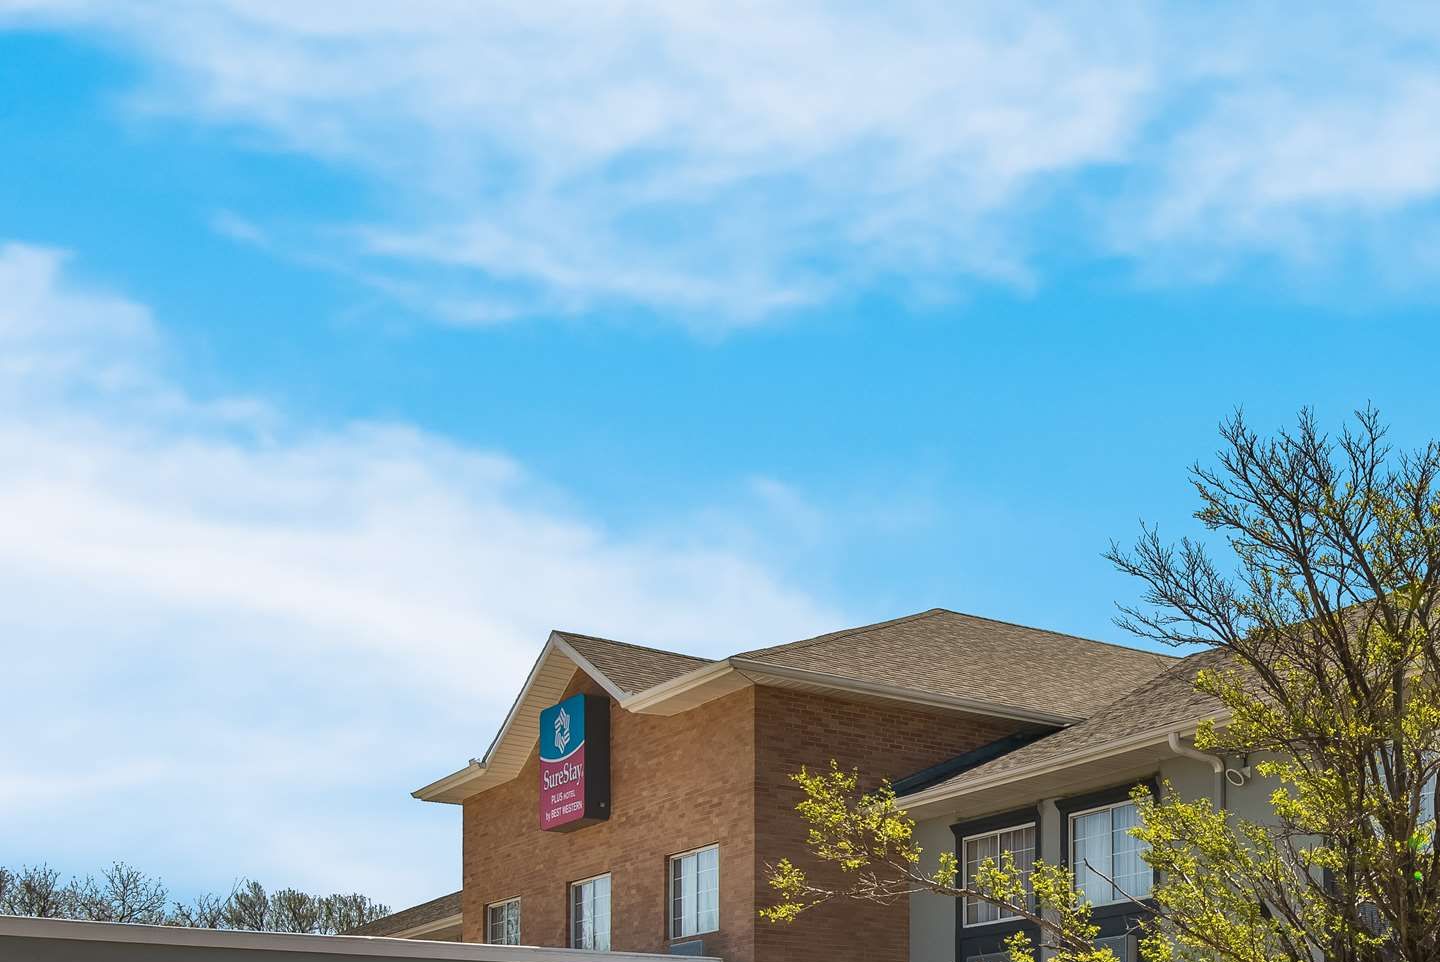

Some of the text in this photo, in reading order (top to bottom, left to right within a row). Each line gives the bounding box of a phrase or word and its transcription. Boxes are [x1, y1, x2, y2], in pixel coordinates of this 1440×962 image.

[551, 791, 563, 804] PLUS
[551, 807, 562, 819] BEST
[562, 800, 583, 815] WESTERN
